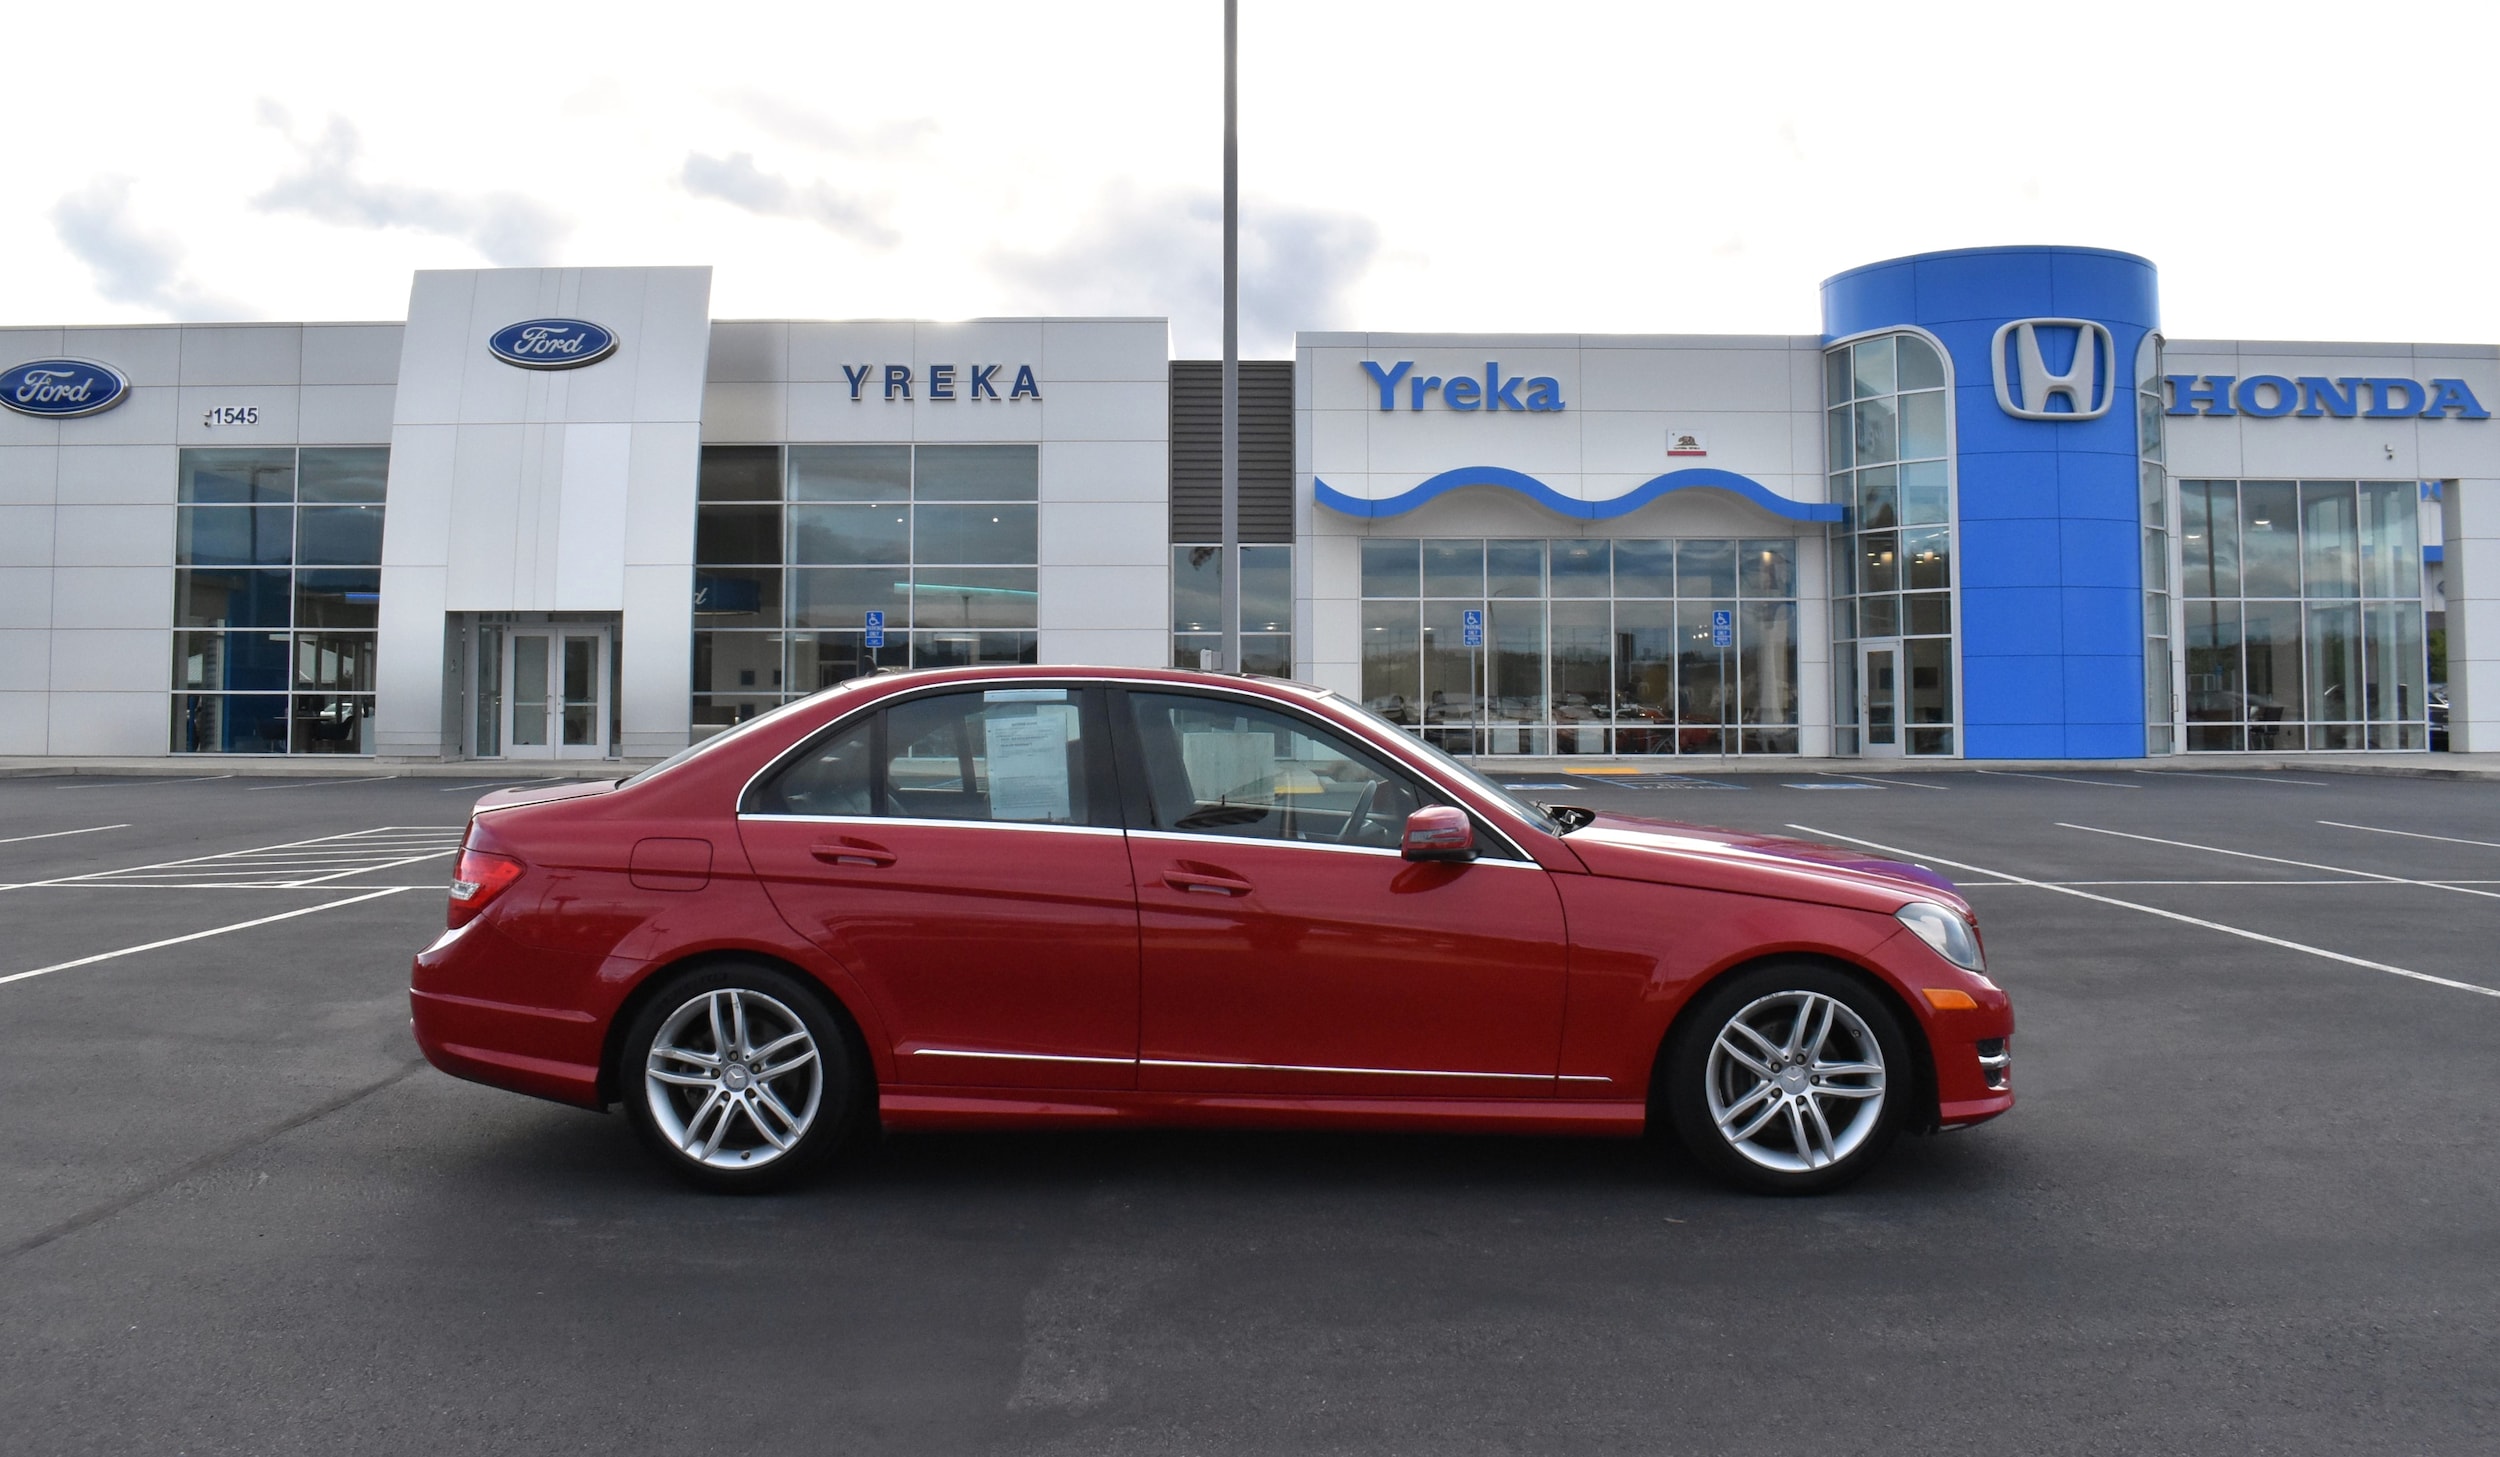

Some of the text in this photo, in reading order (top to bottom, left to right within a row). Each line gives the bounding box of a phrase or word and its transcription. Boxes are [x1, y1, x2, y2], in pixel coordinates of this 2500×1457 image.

[513, 326, 587, 354] Ford
[16, 369, 95, 403] Ford
[840, 362, 1043, 400] YREKA
[1359, 361, 1566, 412] Yreka
[2165, 374, 2492, 419] HONDA
[214, 407, 258, 424] 1545
